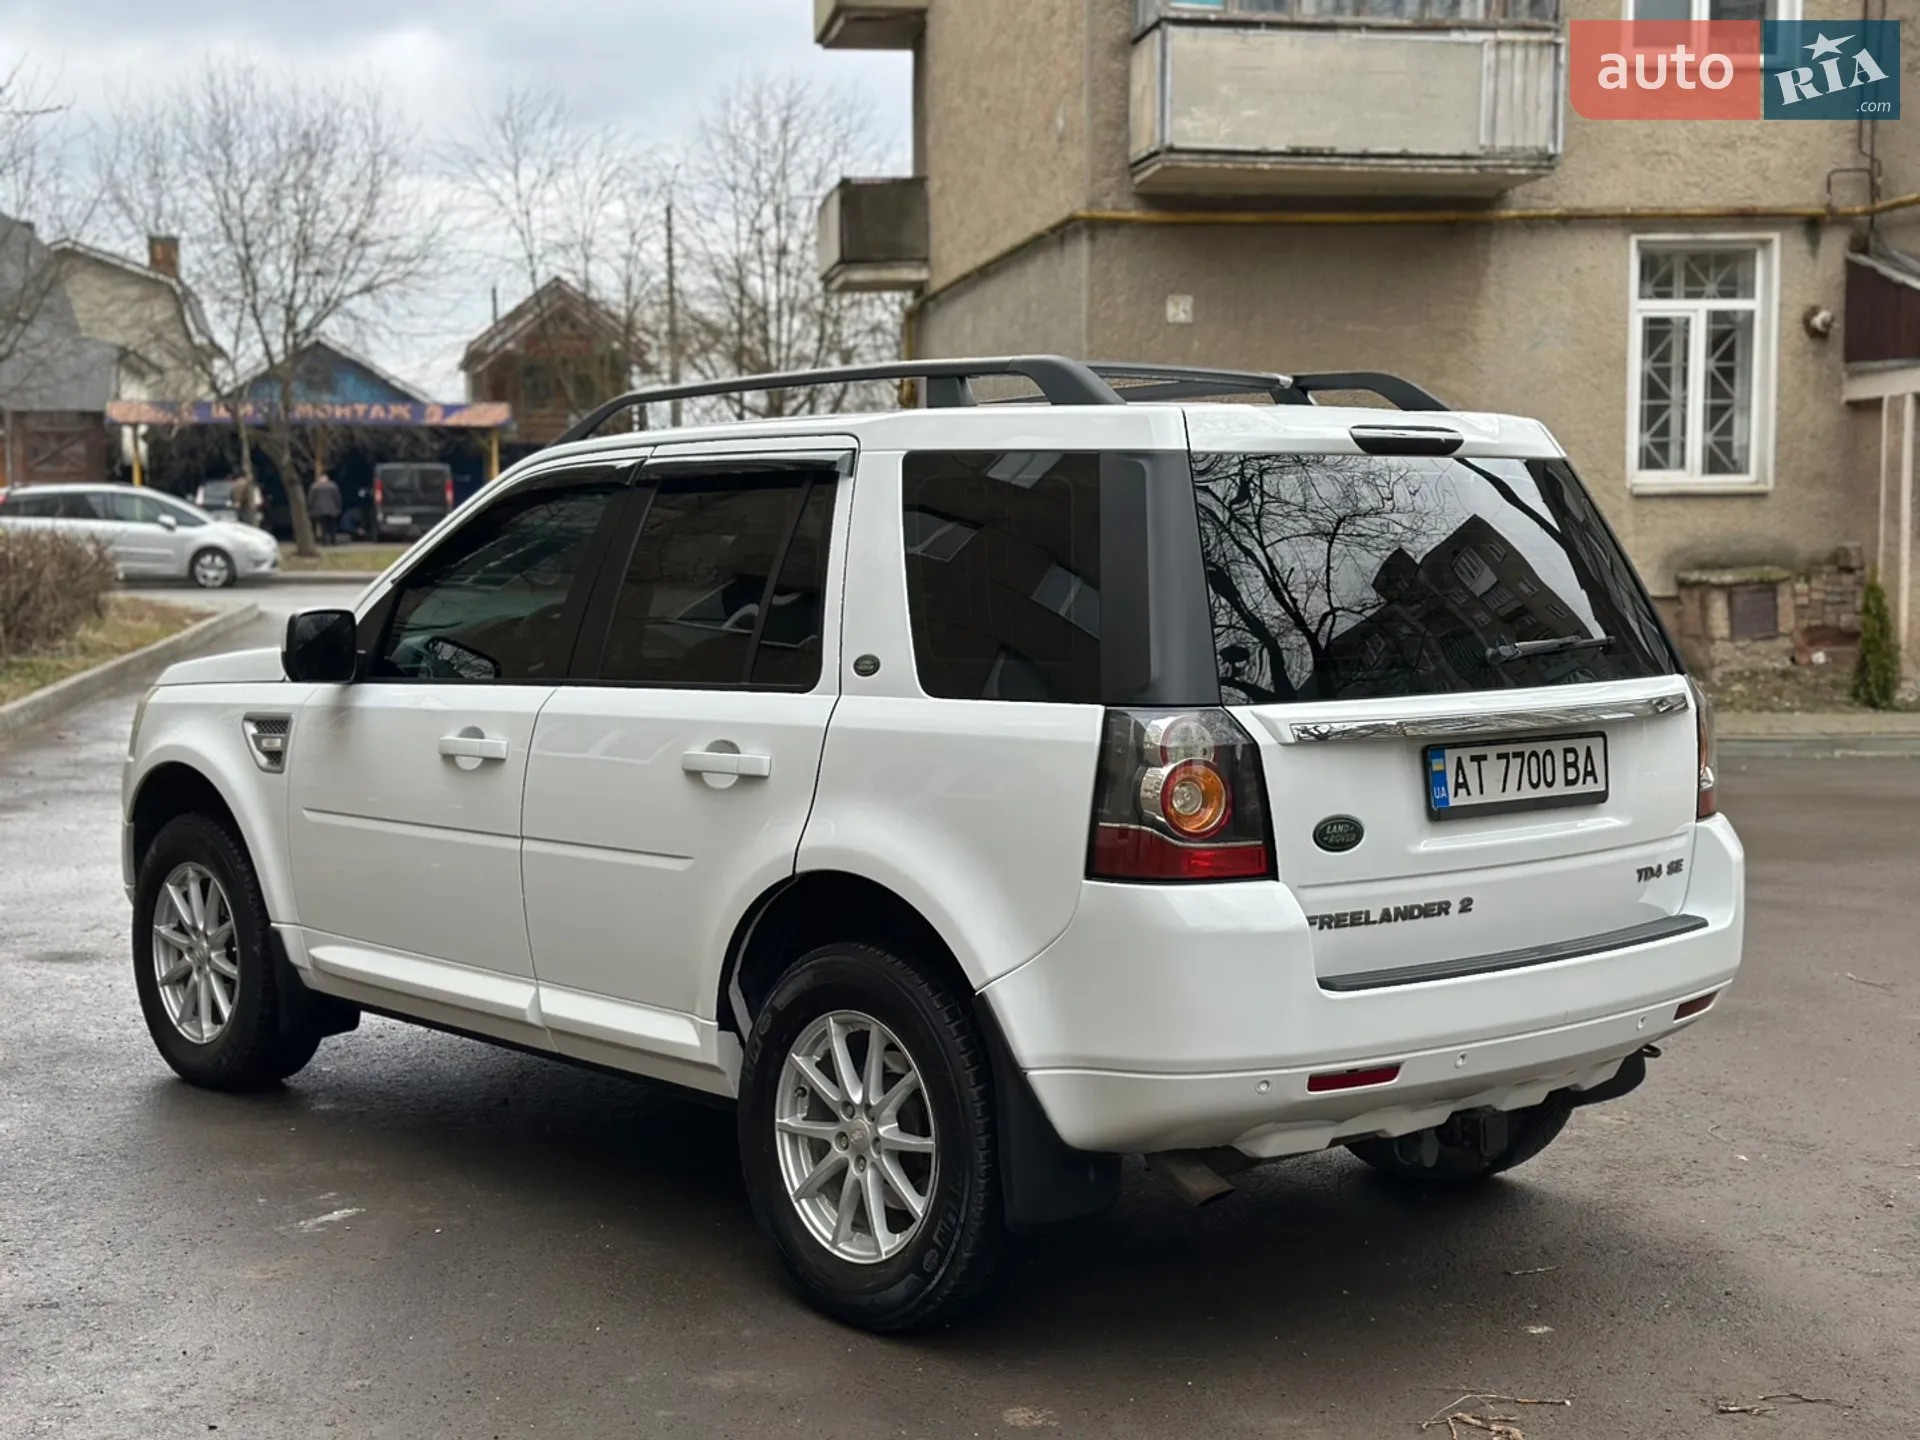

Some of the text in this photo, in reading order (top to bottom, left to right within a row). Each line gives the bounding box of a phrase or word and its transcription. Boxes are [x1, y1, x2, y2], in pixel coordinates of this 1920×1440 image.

[1433, 746, 1599, 799] UA AT 7700 BA
[1326, 823, 1349, 834] LAND
[1328, 833, 1357, 844] ROVER
[1666, 858, 1684, 876] SE
[1306, 896, 1474, 931] FREELANDER 2
